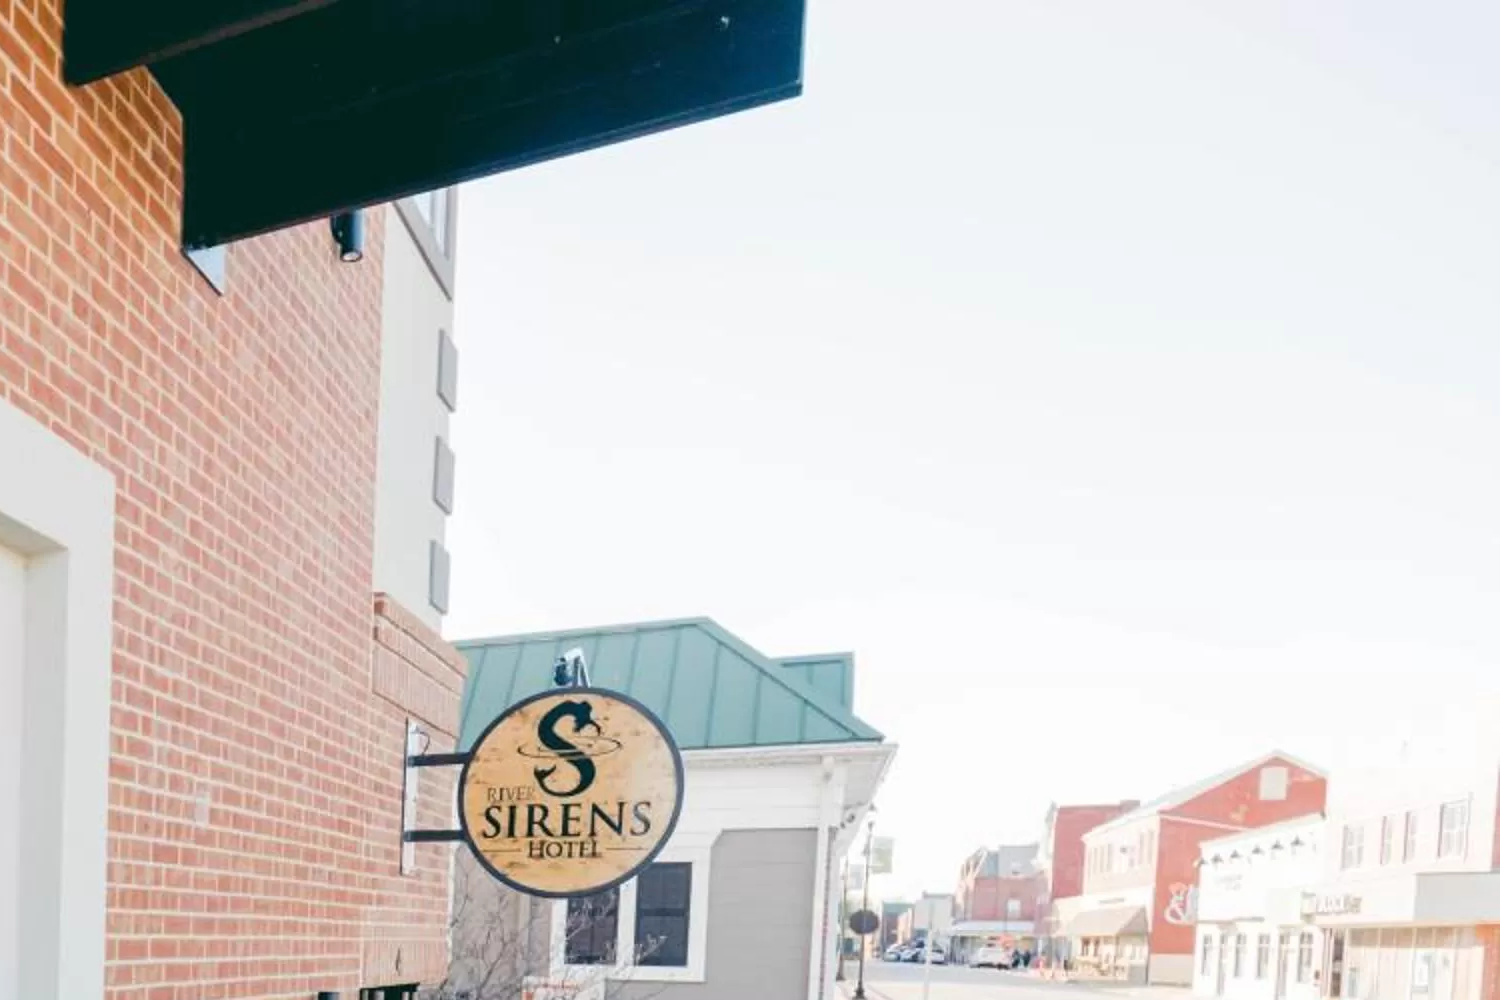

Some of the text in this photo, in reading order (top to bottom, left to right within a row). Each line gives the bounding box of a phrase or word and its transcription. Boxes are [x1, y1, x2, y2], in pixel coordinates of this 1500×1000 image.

[487, 786, 536, 802] RIVER
[481, 800, 652, 839] SIRENS
[527, 837, 603, 859] HOTEL
